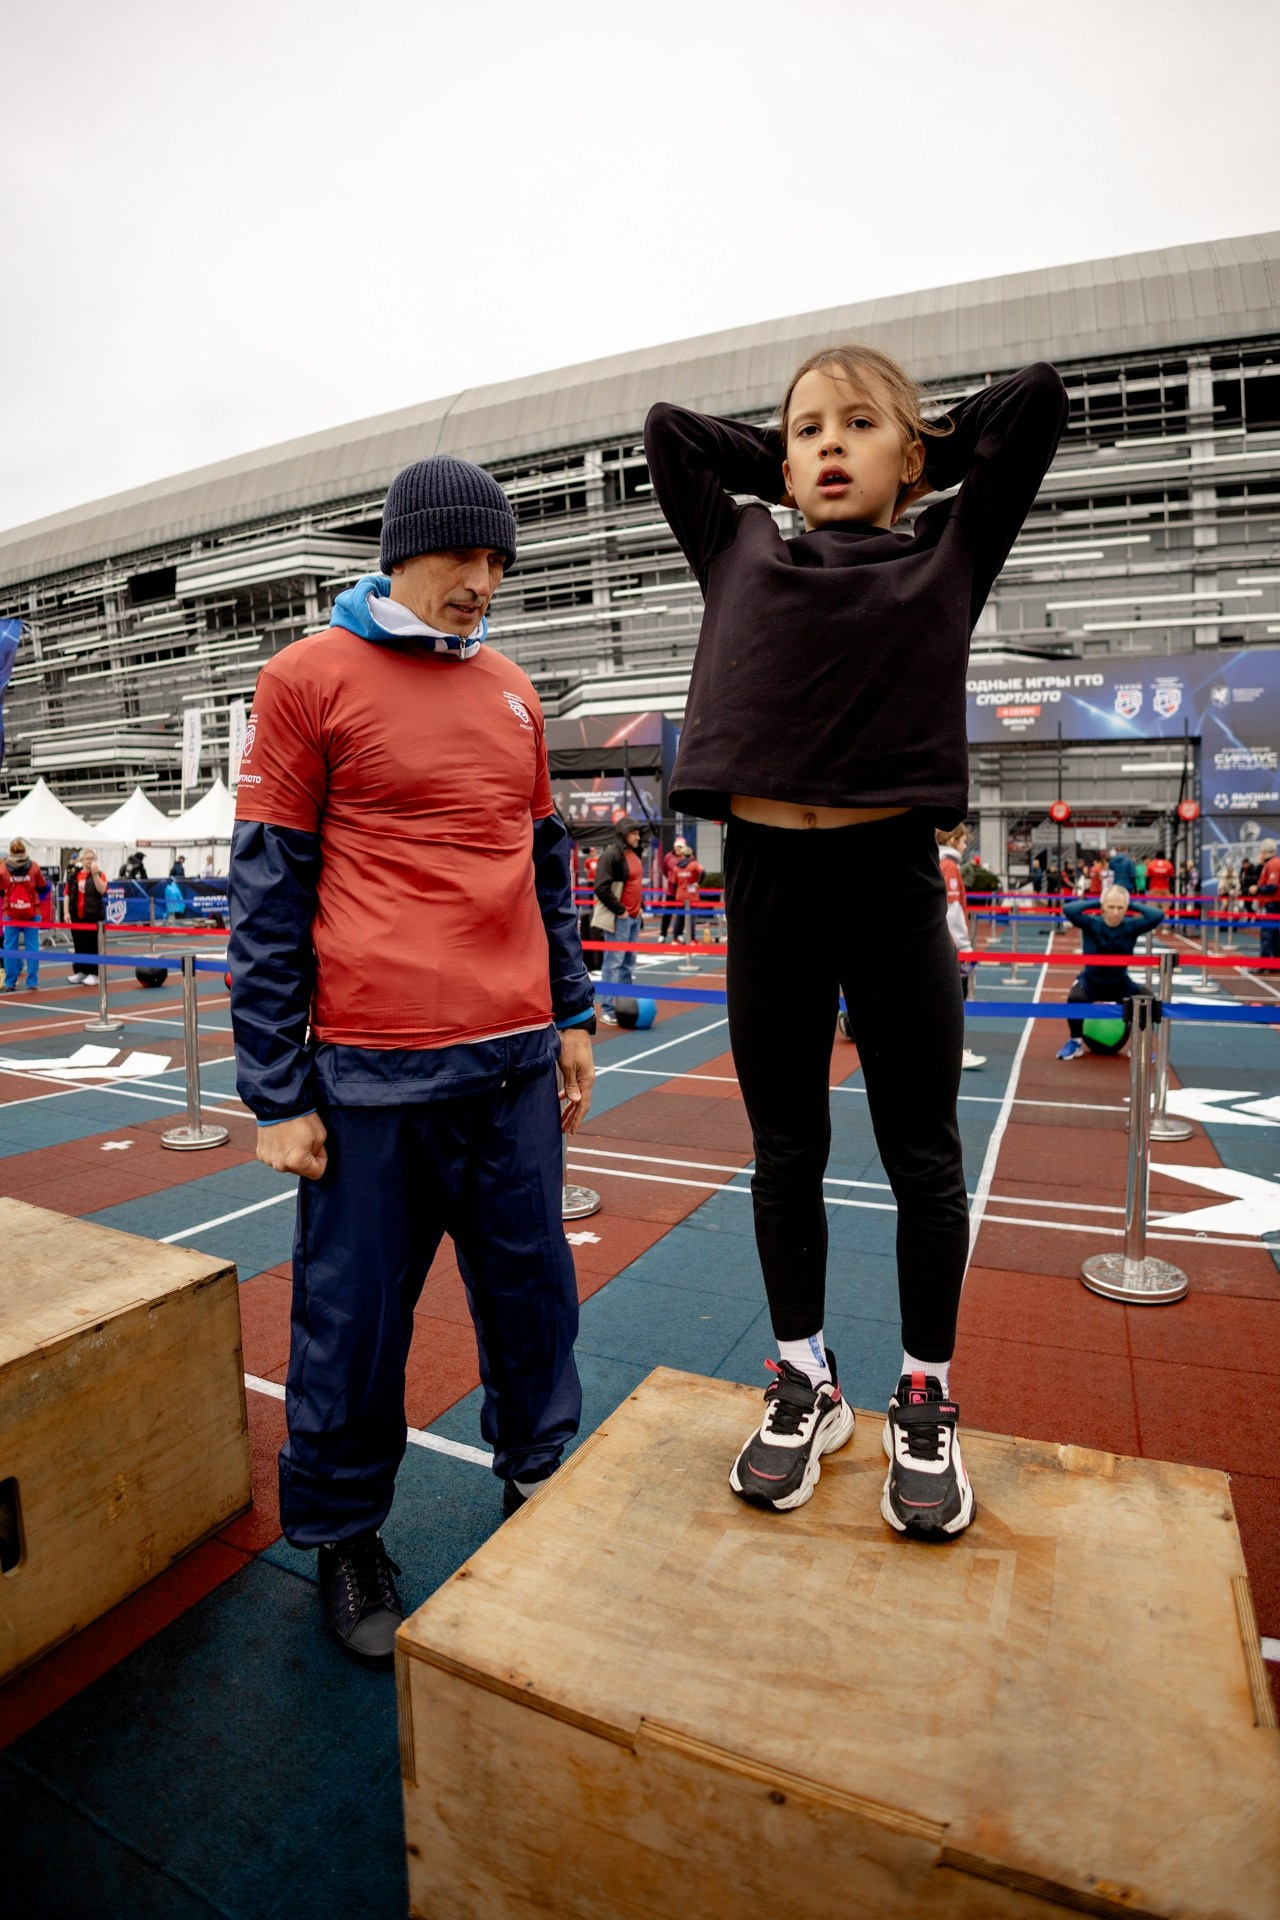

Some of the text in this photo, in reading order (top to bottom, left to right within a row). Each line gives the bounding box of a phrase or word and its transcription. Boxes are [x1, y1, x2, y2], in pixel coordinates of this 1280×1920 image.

[966, 673, 1104, 693] ОДНЫЕ ИГРЫ ГТО
[976, 690, 1062, 706] СПОРТЛОТО
